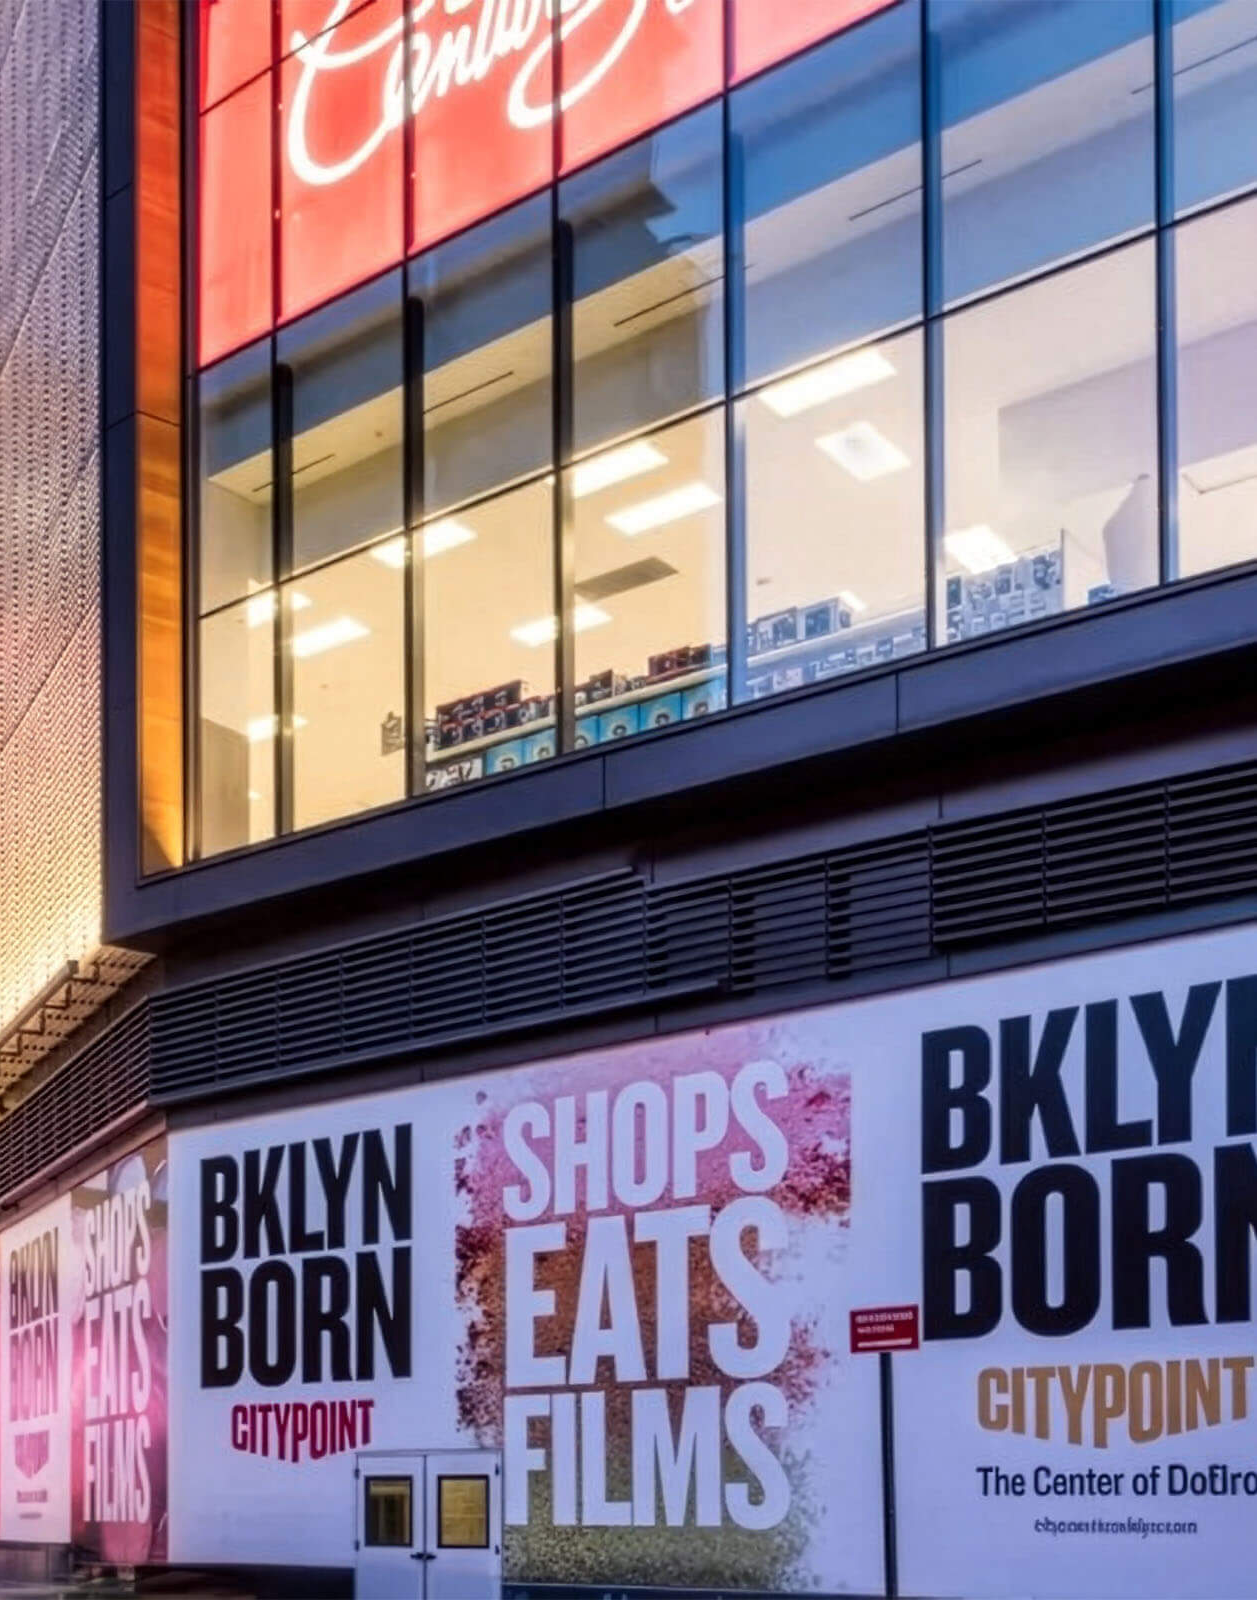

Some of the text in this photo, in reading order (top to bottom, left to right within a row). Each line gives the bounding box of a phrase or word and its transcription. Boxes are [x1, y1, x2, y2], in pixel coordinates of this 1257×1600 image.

[200, 1123, 413, 1265] BKLYN
[503, 1060, 788, 1222] SHOPS
[84, 1178, 151, 1297] SHOPS
[504, 1195, 791, 1388] EATS
[84, 1278, 152, 1421] EATS
[200, 1246, 413, 1389] BORN
[84, 1415, 152, 1523] FILMS
[231, 1400, 374, 1463] CITYPOINT
[504, 1382, 791, 1530] FILMS
[978, 1356, 1255, 1449] CITYPOINT
[976, 1465, 1026, 1497] The
[1033, 1465, 1125, 1497] Center
[1132, 1465, 1161, 1497] of
